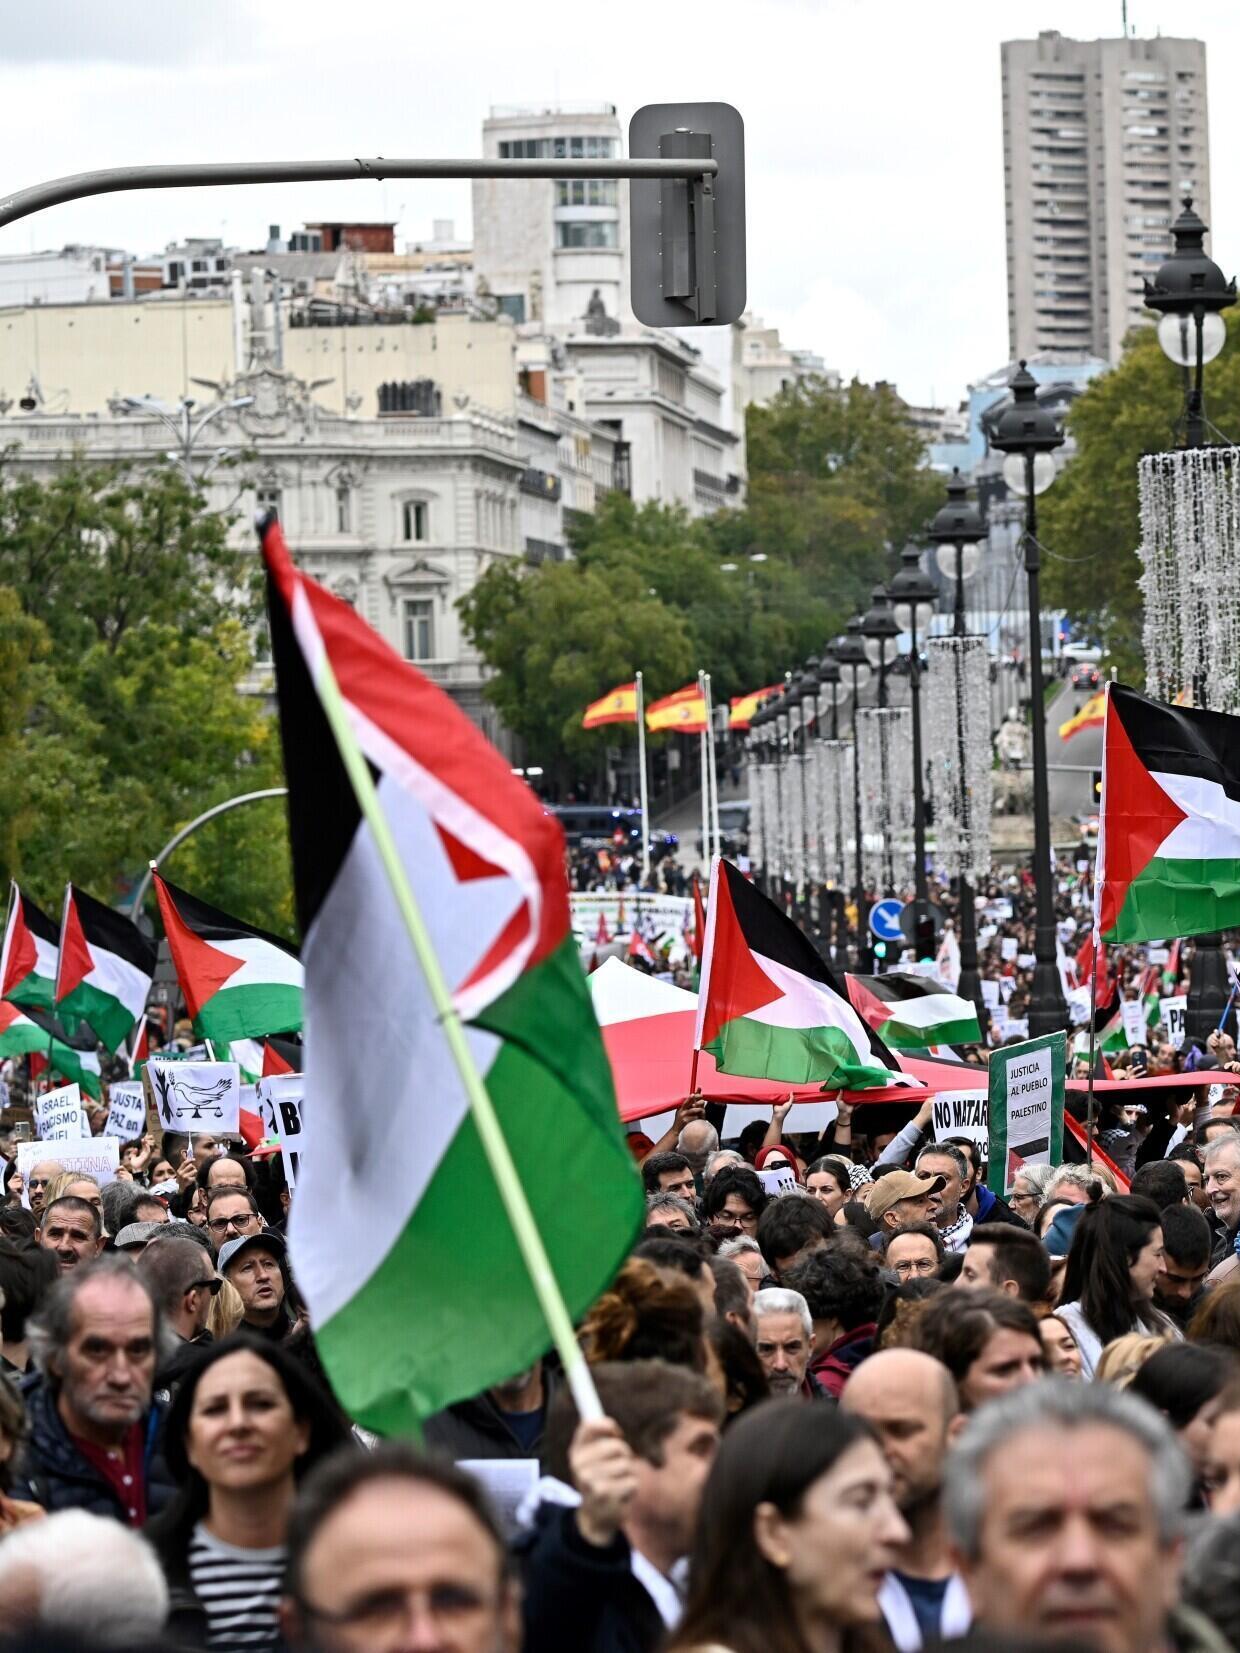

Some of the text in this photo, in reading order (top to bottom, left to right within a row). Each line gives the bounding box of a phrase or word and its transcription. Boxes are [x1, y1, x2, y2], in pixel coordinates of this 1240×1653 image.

[1010, 1062, 1040, 1080] JUSTICIA
[1010, 1077, 1048, 1097] AL PUEBLO
[113, 1091, 142, 1111] JUSTA
[1010, 1101, 1048, 1120] PALESTINO
[42, 1110, 78, 1133] RACISMO
[109, 1111, 138, 1132] PAZ en
[934, 1100, 988, 1129] NO MATAR
